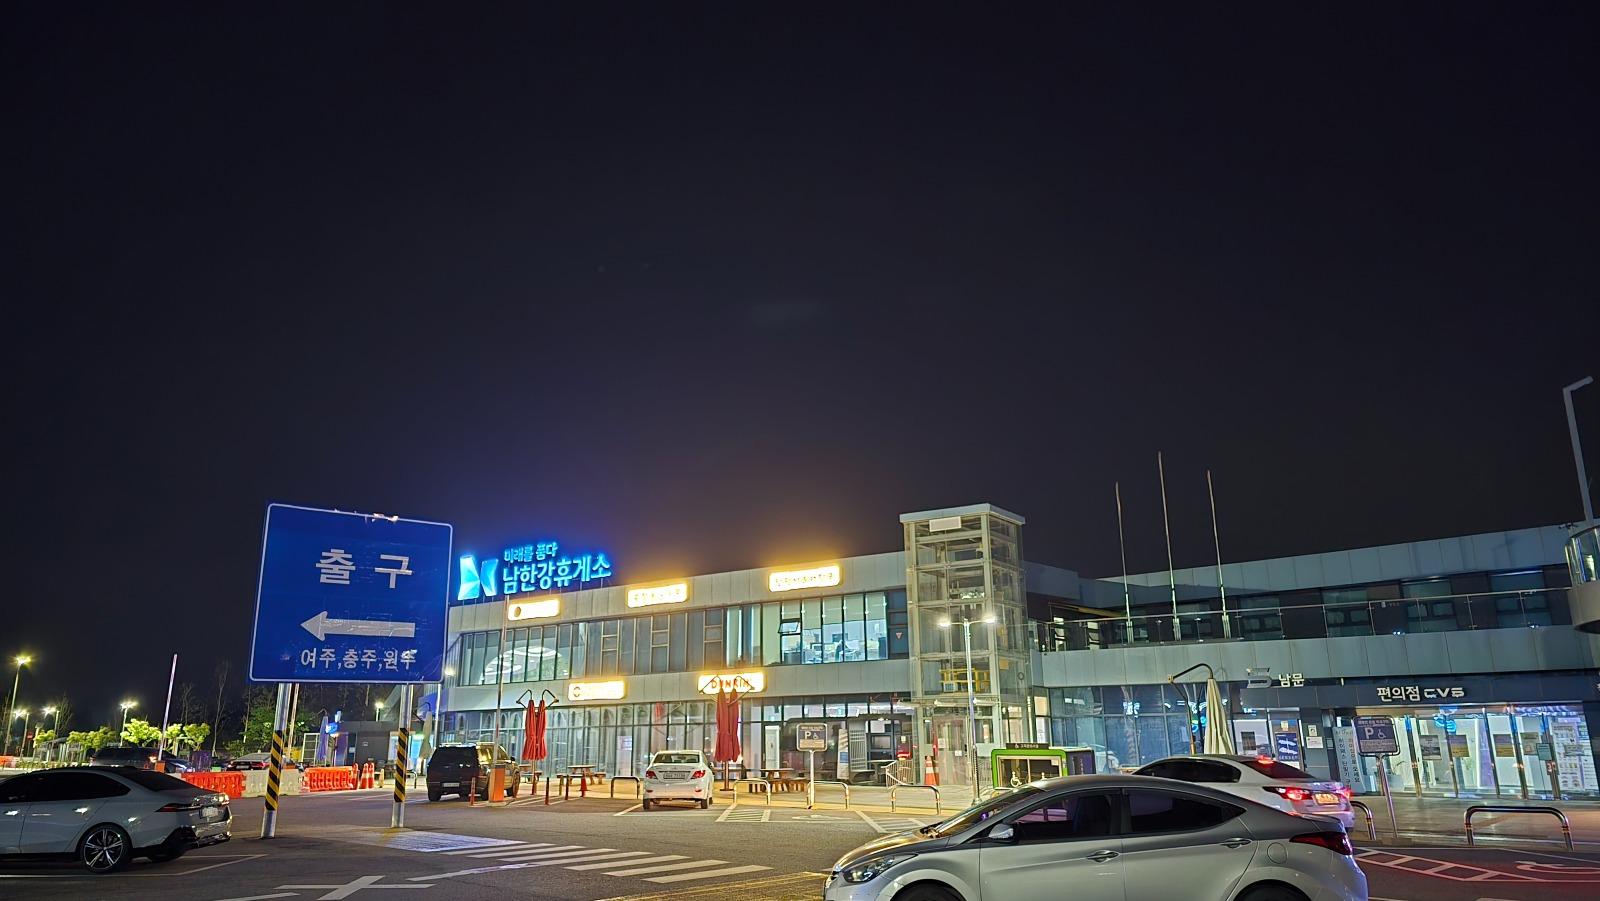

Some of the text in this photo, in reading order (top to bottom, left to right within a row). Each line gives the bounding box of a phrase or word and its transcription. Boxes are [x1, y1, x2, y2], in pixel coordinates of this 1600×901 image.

[503, 541, 558, 563] 미래를 품다
[503, 553, 612, 594] 남한강휴게소
[1278, 673, 1305, 688] 남문
[1376, 686, 1465, 702] 편의점 CVS
[1364, 728, 1374, 740] P
